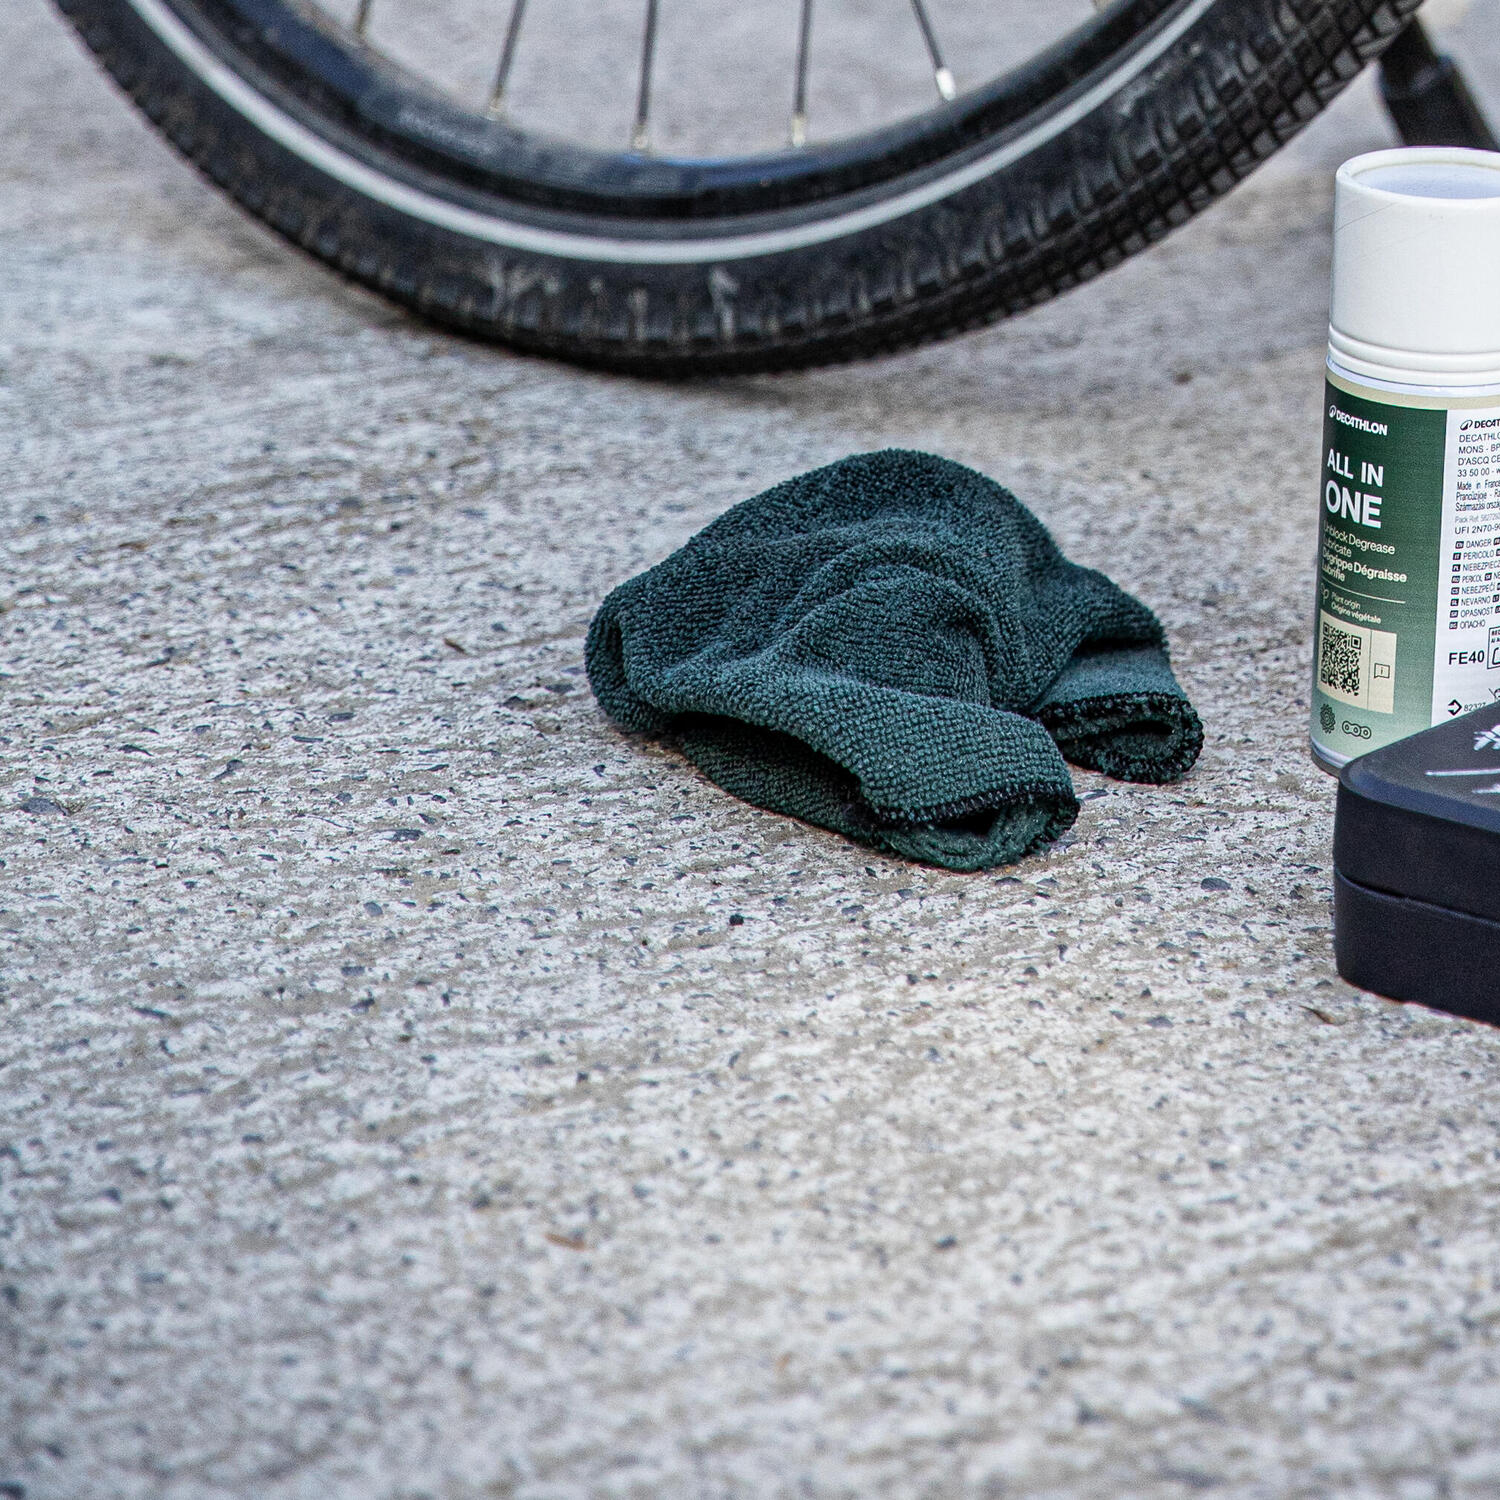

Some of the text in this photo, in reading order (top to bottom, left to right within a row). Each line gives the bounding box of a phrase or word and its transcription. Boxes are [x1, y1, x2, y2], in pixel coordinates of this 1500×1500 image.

[1336, 410, 1388, 436] DECATHLON
[1458, 445, 1484, 455] MONS
[1490, 443, 1500, 452] BP
[1457, 456, 1489, 466] D'ASCQ
[1327, 448, 1384, 487] ALL IN
[1457, 469, 1467, 477] 33
[1469, 468, 1479, 476] 50
[1480, 467, 1490, 475] 00
[1456, 481, 1472, 490] Made
[1476, 481, 1481, 489] in
[1485, 479, 1500, 488] France
[1325, 479, 1382, 529] ONE
[1454, 526, 1470, 535] UFI
[1348, 533, 1396, 555] Degrease
[1466, 539, 1492, 548] DANGER
[1463, 549, 1494, 560] PERICOLO
[1353, 562, 1408, 582] Dégraisse
[1343, 597, 1361, 610] origin
[1461, 595, 1491, 606] NEVARNO
[1350, 608, 1381, 624] végétale
[1460, 607, 1493, 618] OPASNOST
[1460, 619, 1486, 629] ОПАСНО
[1449, 650, 1485, 665] FE40
